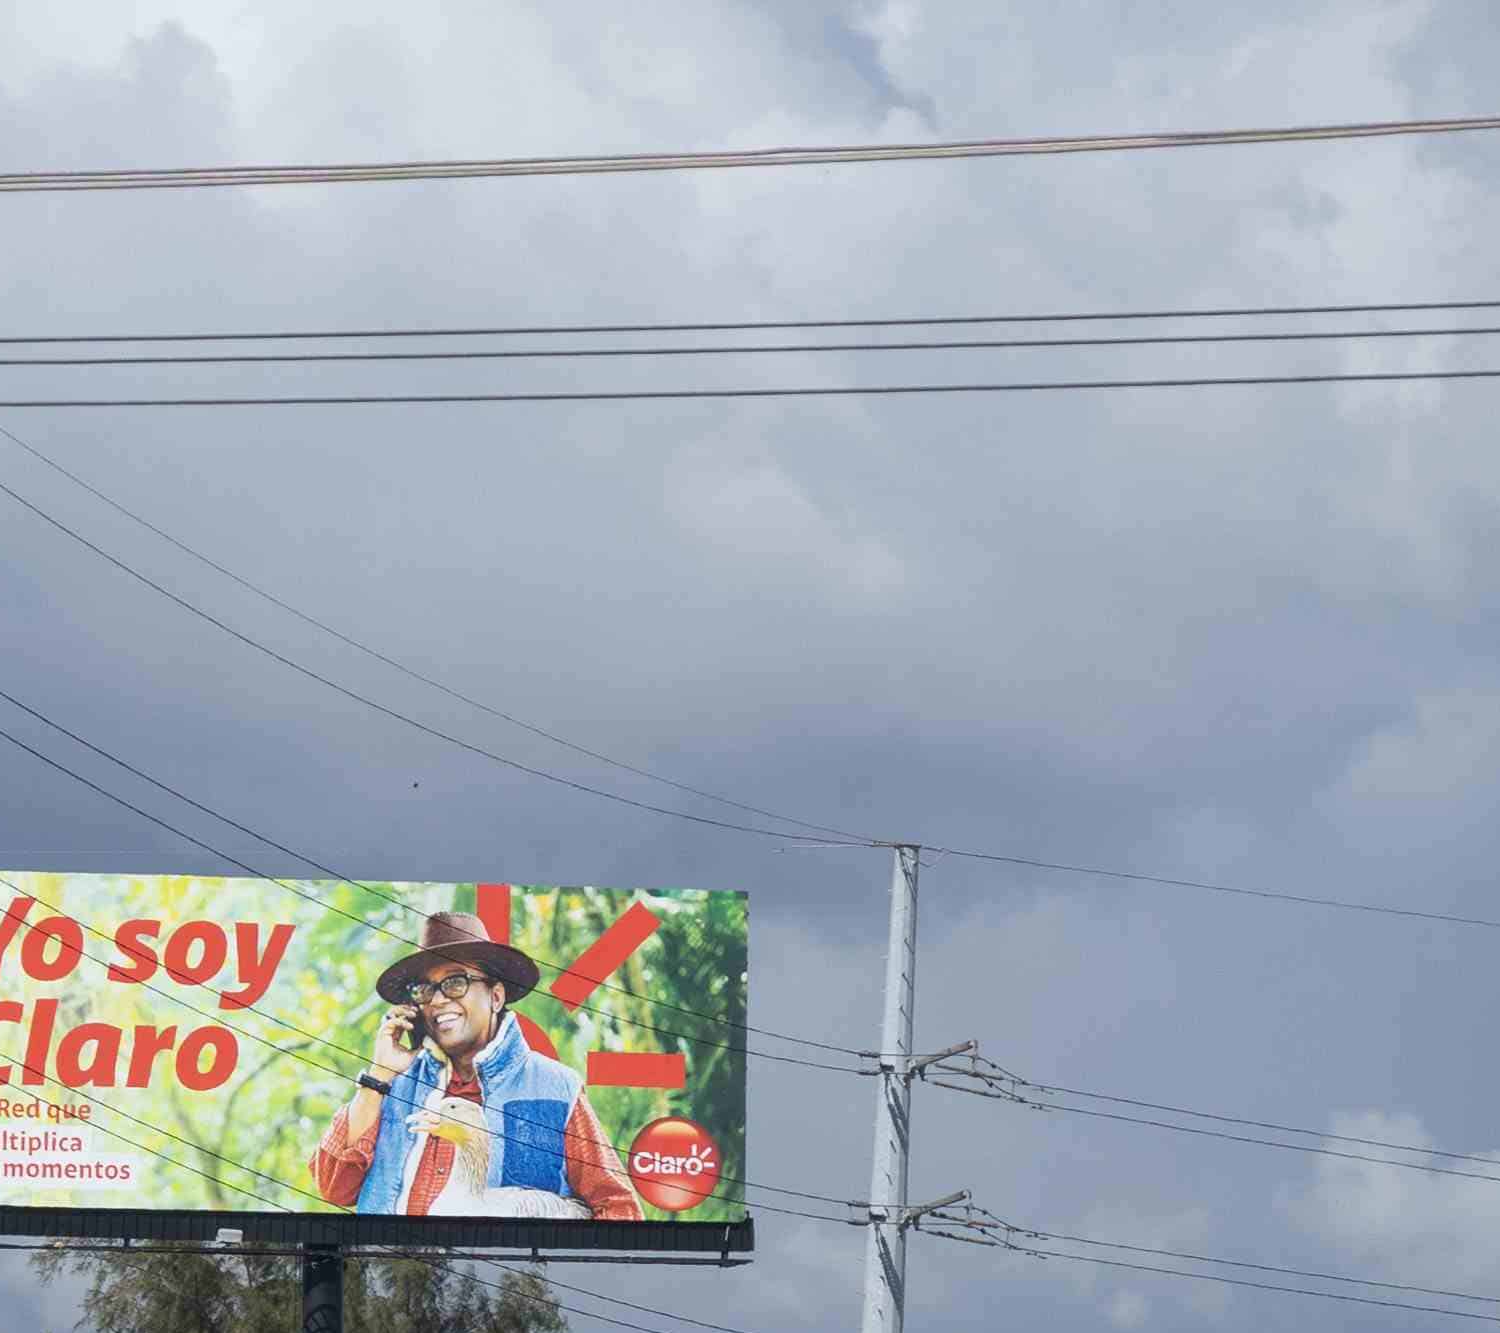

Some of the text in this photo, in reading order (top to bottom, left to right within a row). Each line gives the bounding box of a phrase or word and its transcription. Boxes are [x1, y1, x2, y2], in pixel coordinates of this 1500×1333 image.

[106, 919, 296, 1011] soy
[47, 1101, 92, 1124] que
[3, 1163, 131, 1180] momentos
[633, 1148, 706, 1176] Claro
